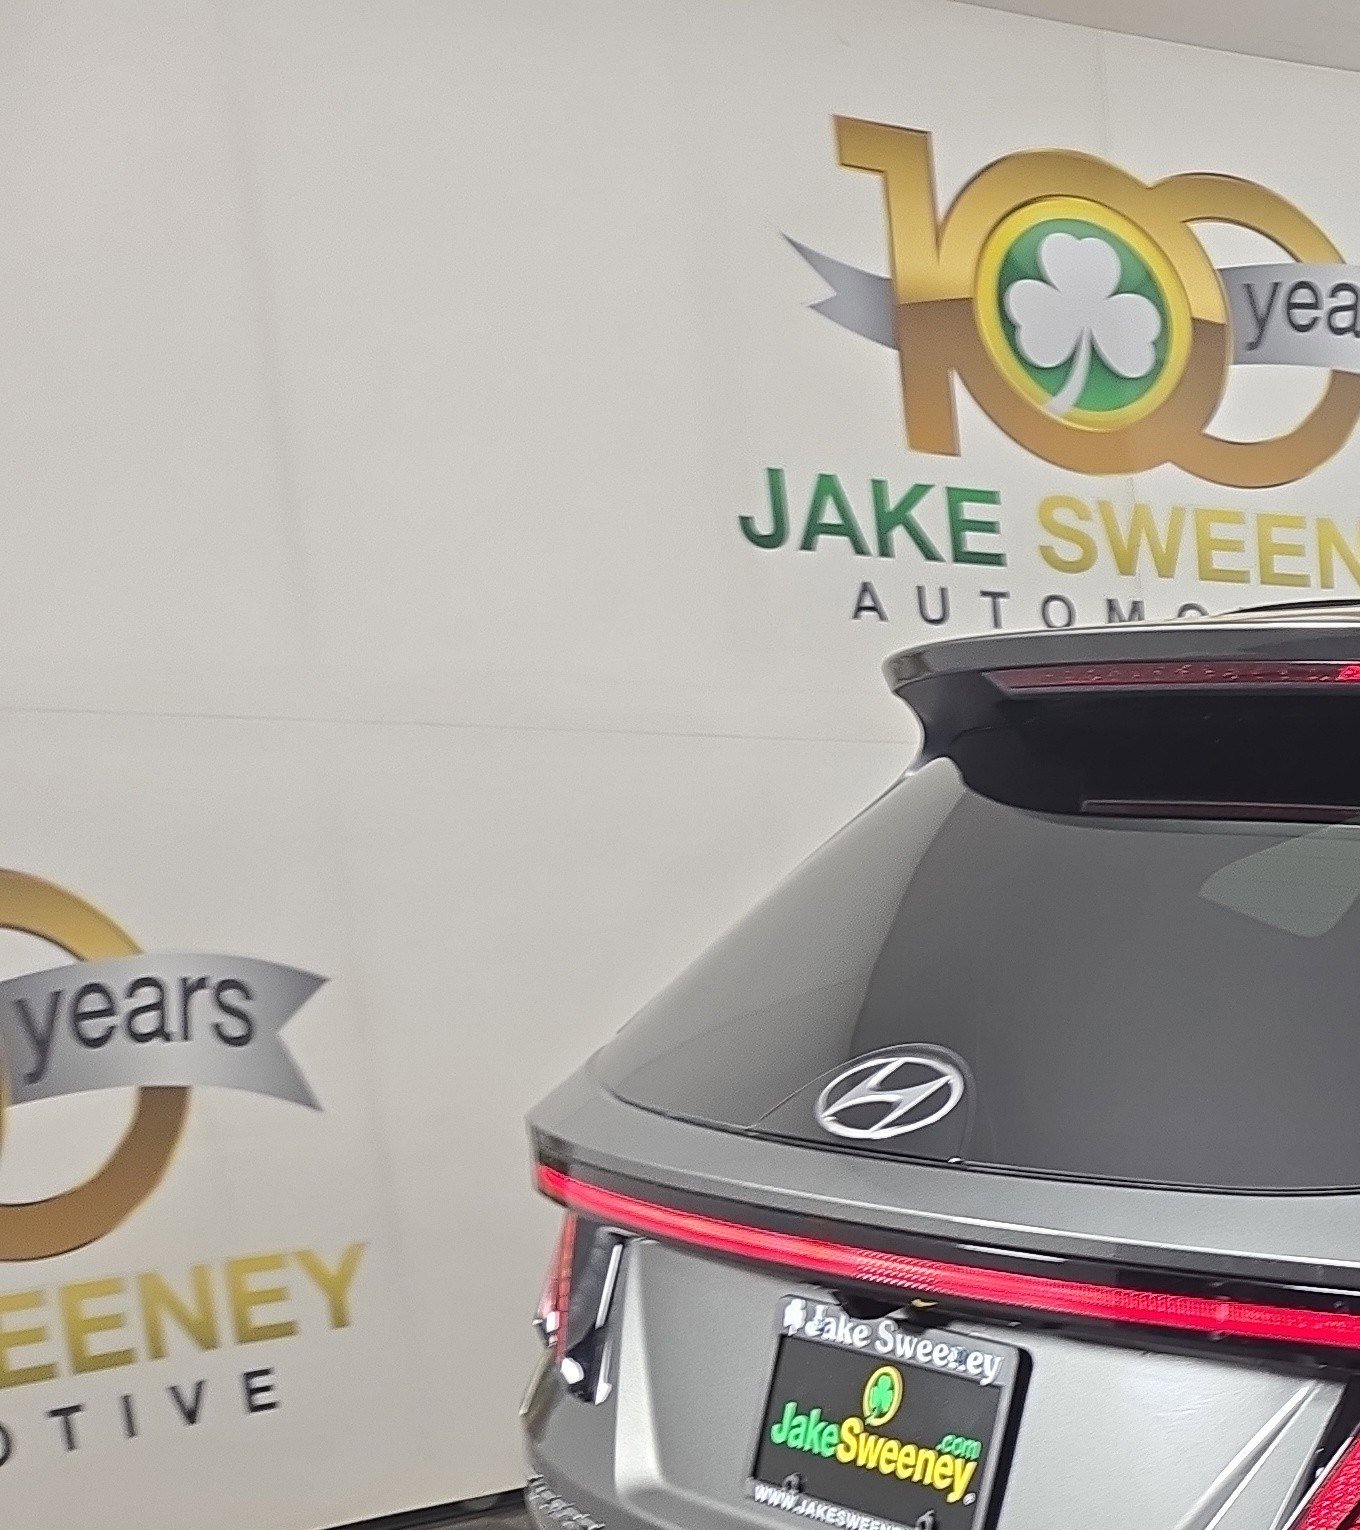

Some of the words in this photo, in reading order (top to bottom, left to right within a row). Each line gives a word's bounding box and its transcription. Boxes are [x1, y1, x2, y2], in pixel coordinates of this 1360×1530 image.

[739, 467, 1008, 567] JAKE
[17, 973, 256, 1084] years
[805, 1304, 872, 1349] Jake
[0, 1366, 280, 1467] TIVE
[771, 1401, 979, 1503] JakeSweeney
